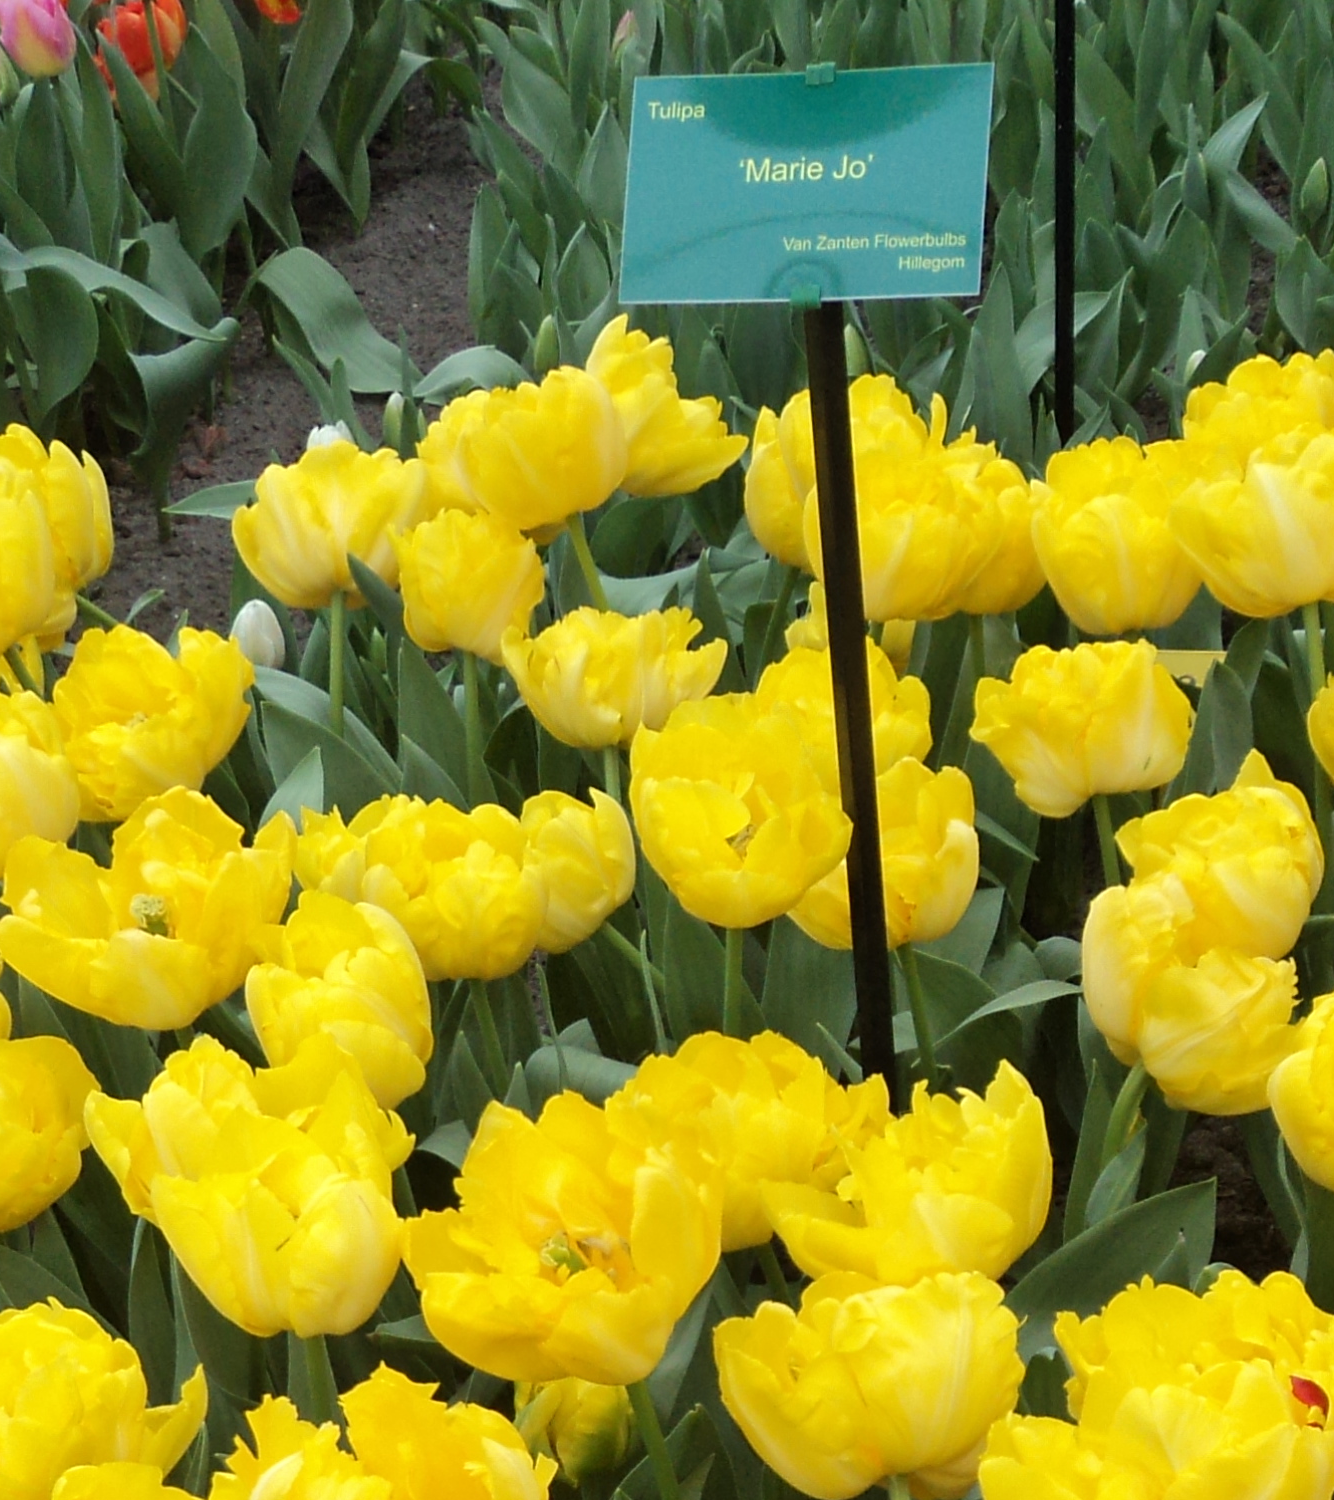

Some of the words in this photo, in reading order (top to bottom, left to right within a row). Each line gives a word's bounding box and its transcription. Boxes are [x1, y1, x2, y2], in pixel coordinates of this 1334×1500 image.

[648, 102, 705, 122] Tulipa
[783, 236, 812, 251] Van
[816, 235, 868, 250] Zanten
[874, 232, 966, 248] Flowerbulbs
[898, 256, 965, 272] Hillegom
